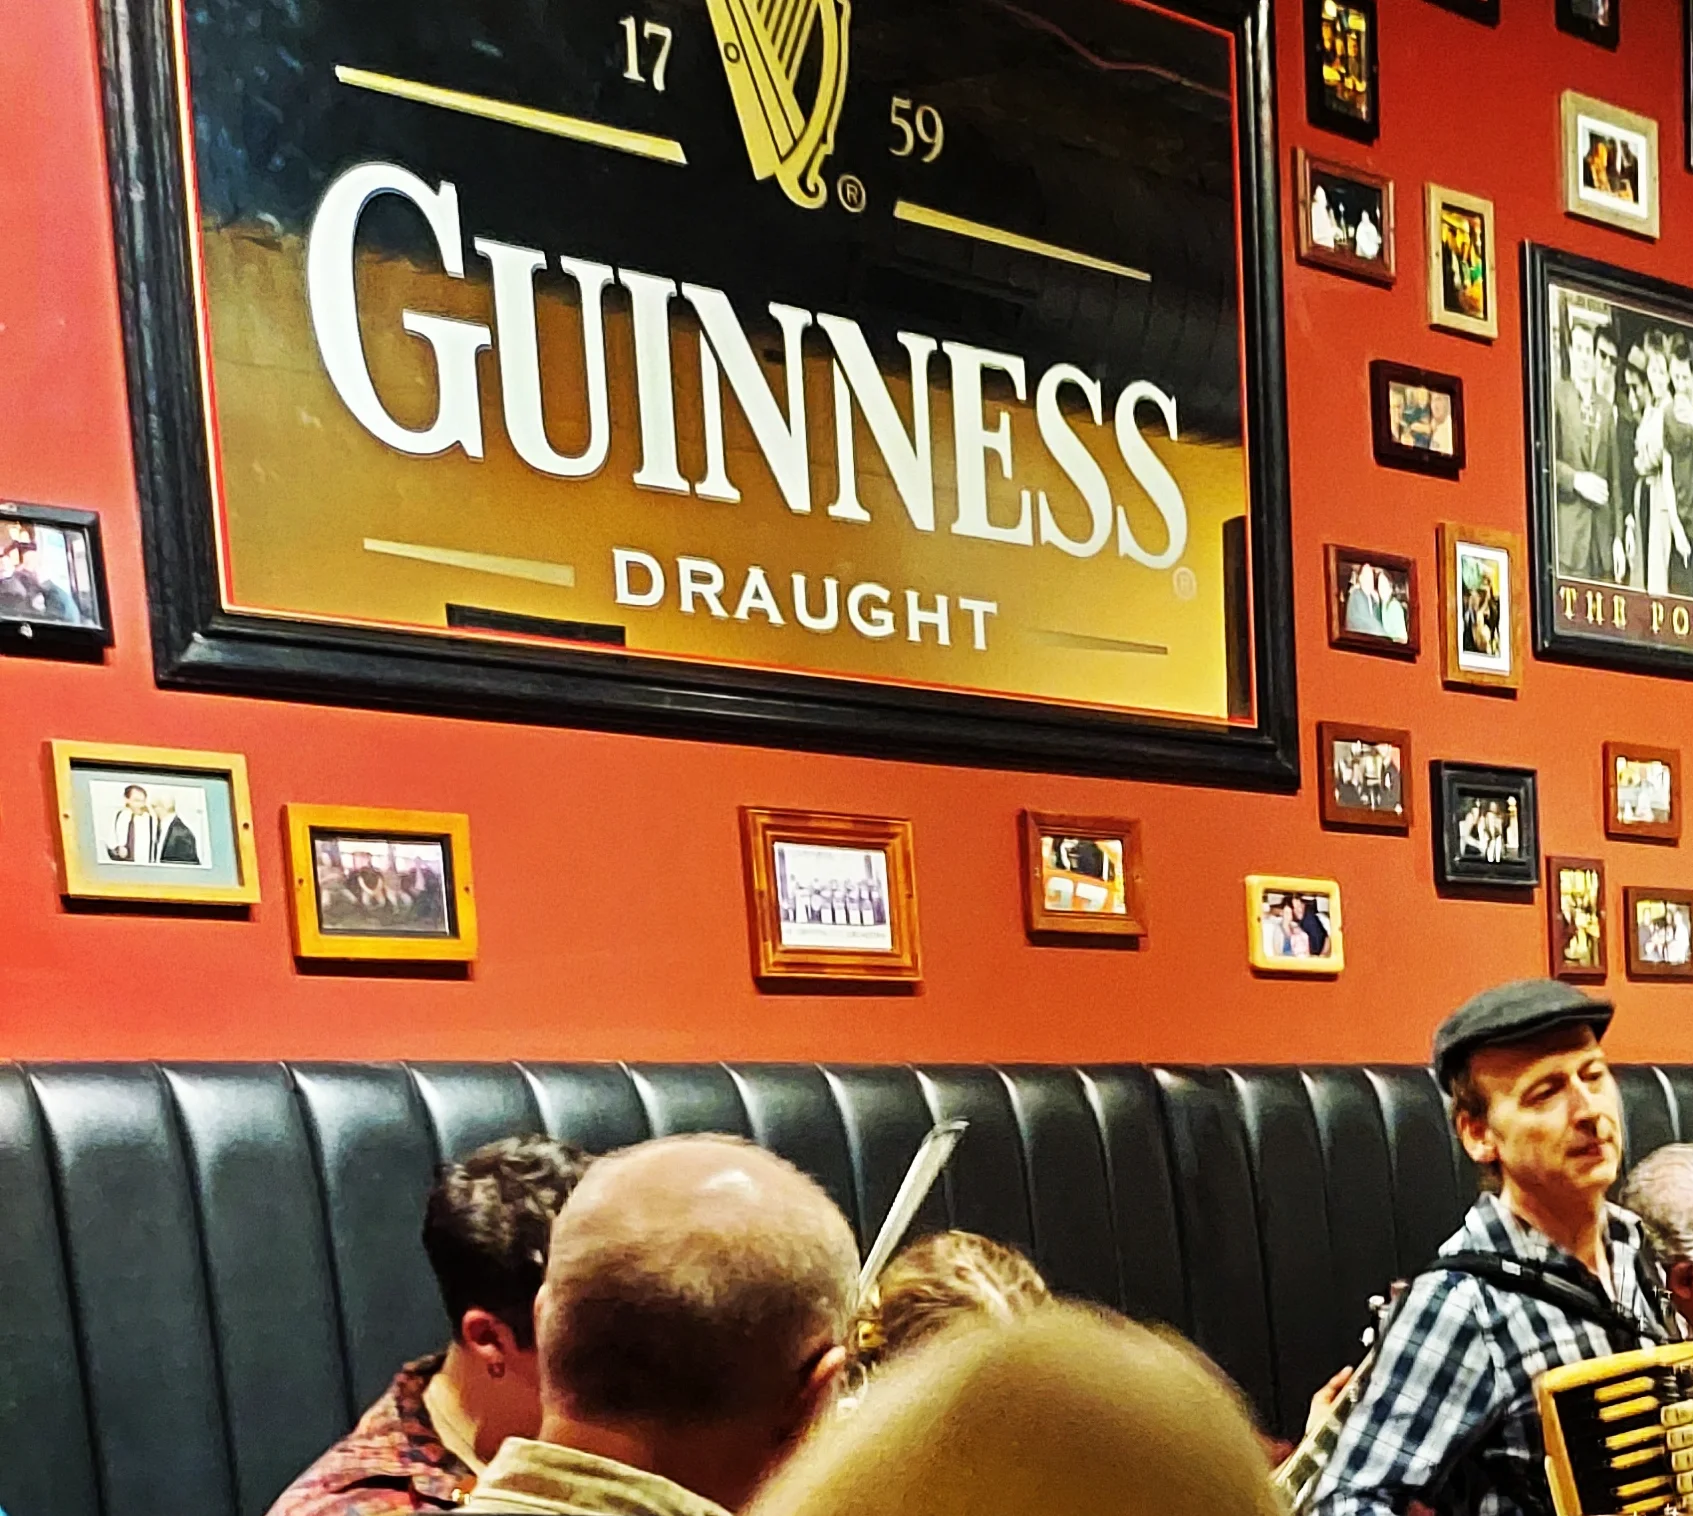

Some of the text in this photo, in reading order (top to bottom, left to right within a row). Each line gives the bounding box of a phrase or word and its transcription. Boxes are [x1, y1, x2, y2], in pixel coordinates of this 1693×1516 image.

[619, 15, 673, 93] 17
[888, 95, 945, 164] 59
[306, 159, 1189, 572] GUINNESS
[611, 547, 999, 651] DRAUGHT
[1559, 586, 1627, 630] THE
